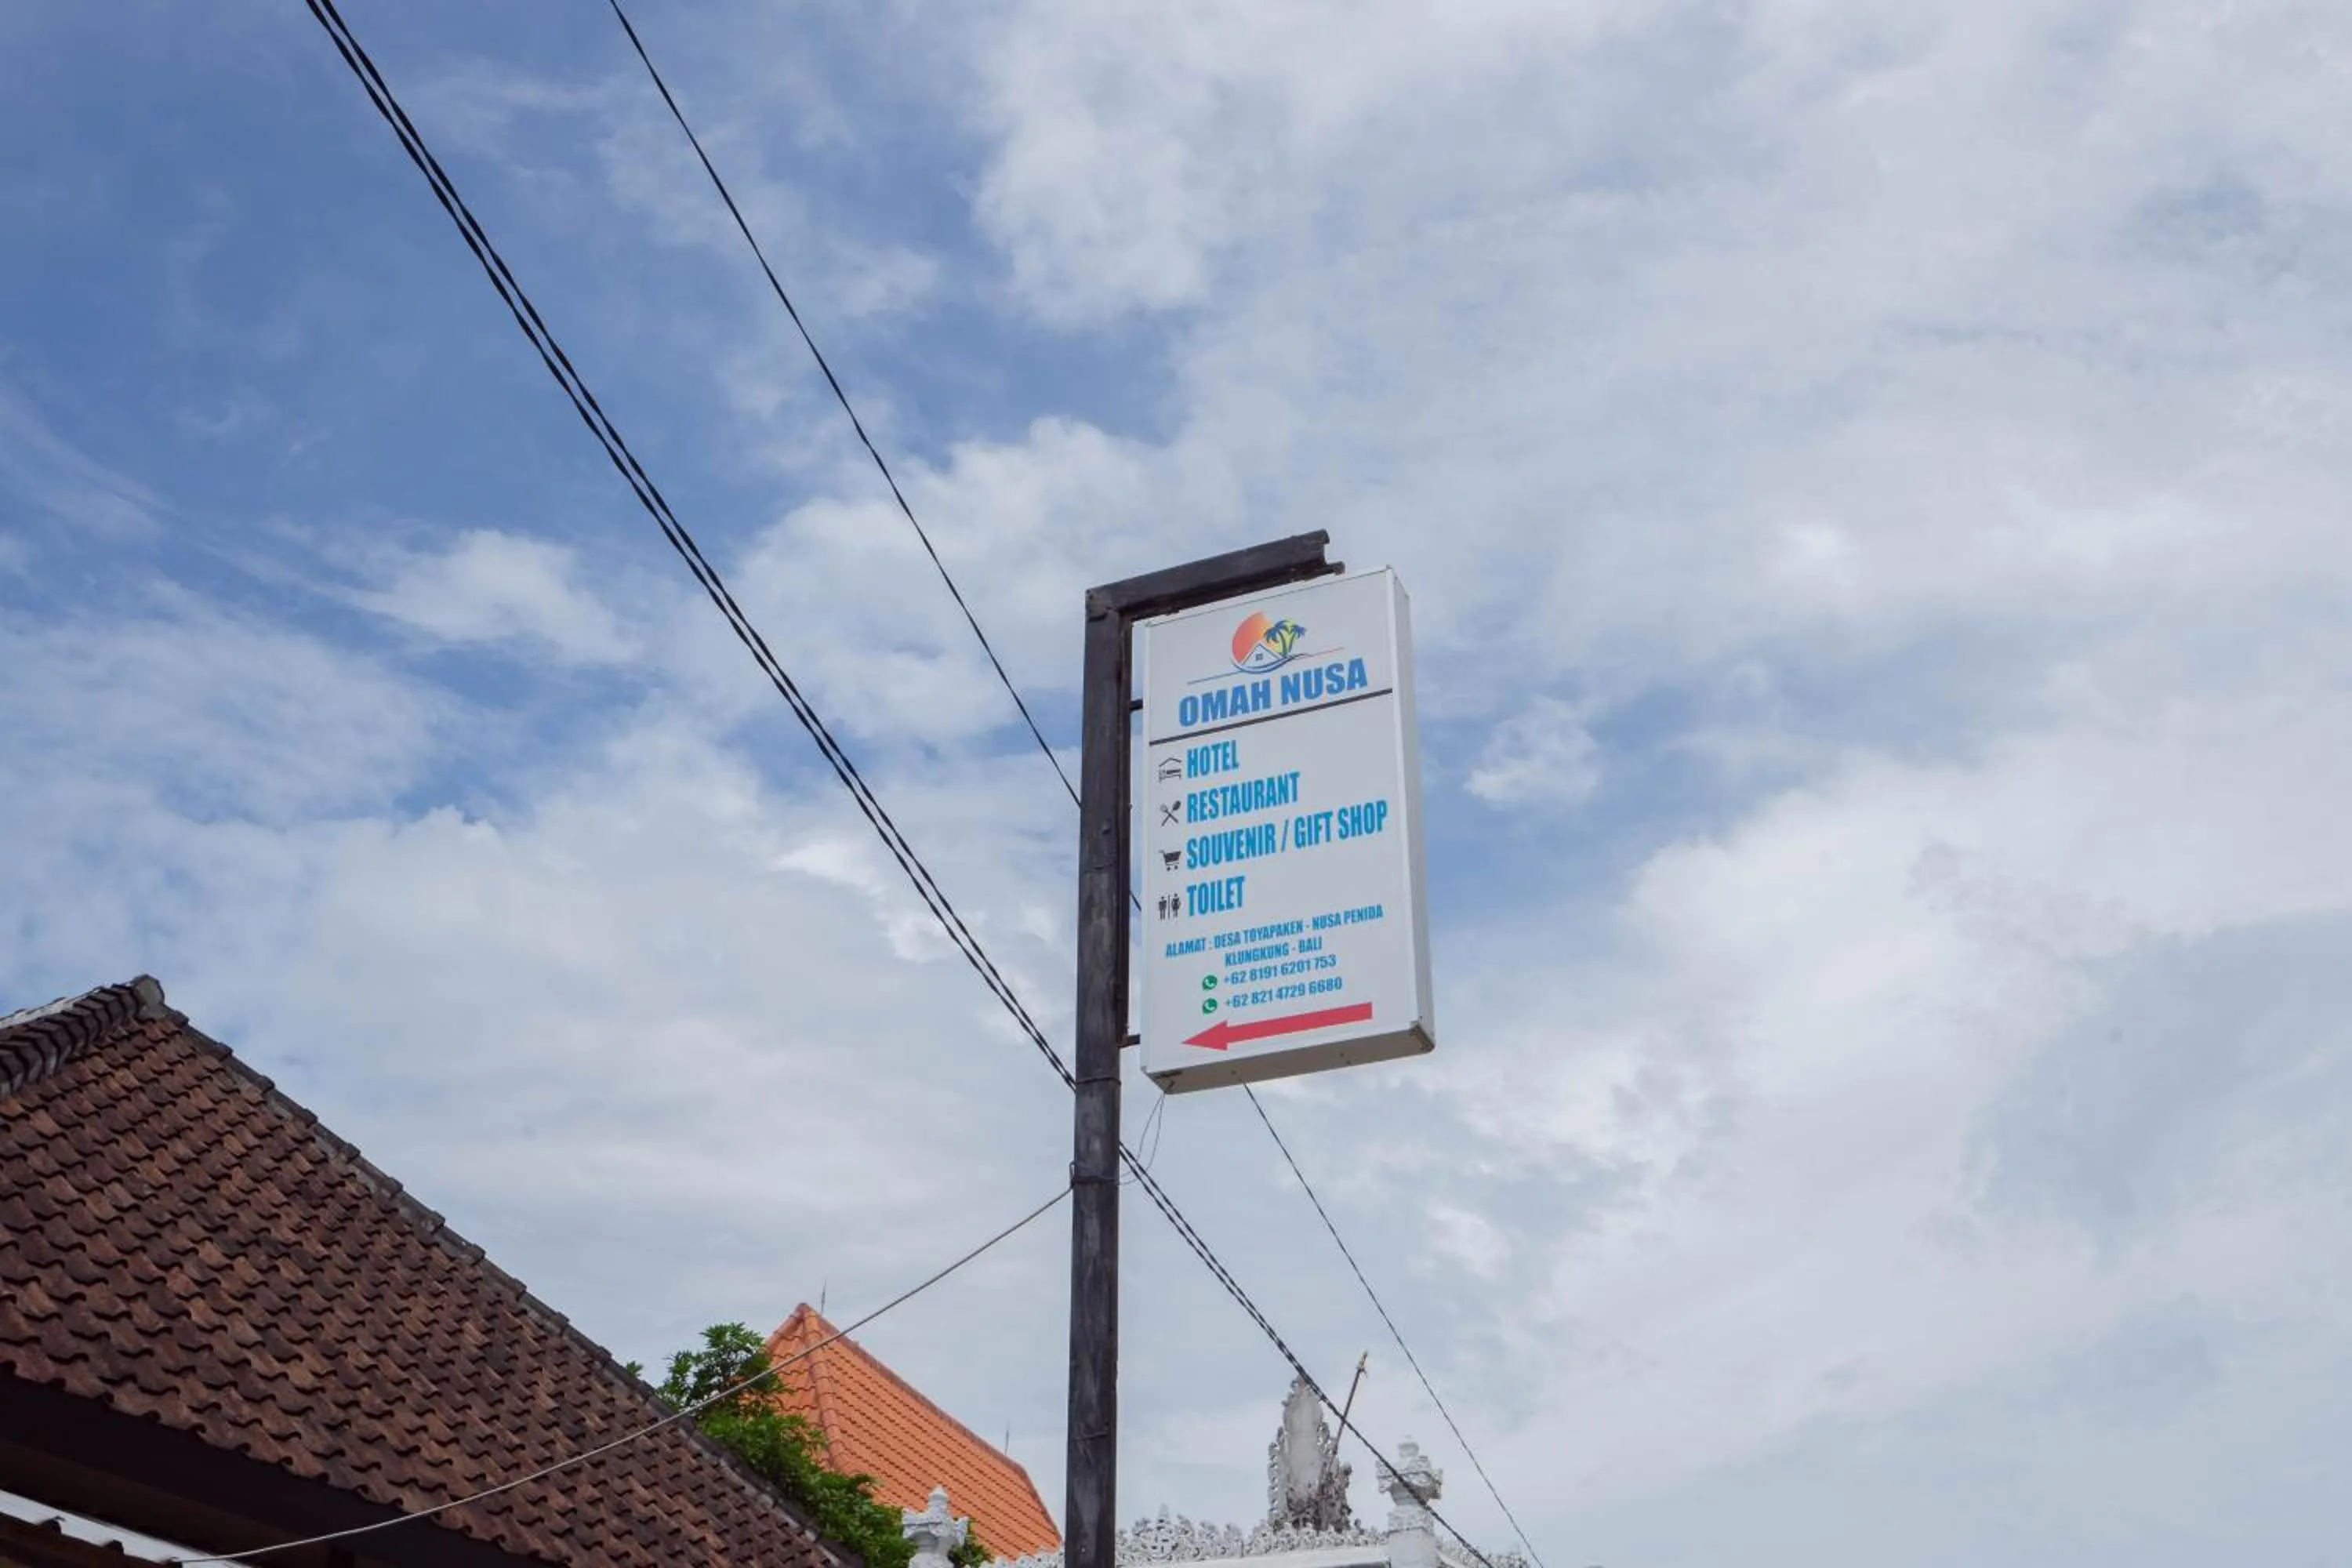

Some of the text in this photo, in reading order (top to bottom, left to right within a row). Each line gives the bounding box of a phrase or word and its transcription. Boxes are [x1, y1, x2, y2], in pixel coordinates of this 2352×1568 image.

[1178, 658, 1367, 727] OMAH NUSA
[1187, 740, 1239, 779] HOTEL
[1187, 771, 1299, 823] RESTAURANT
[1186, 800, 1387, 869] SOUVENIR / GIFT SHOP
[1186, 876, 1245, 916] TOILET
[1166, 938, 1206, 957] ALAMAT
[1214, 931, 1240, 949] DESA
[1312, 913, 1341, 931] NUSA
[1344, 904, 1383, 924] PENIDA
[1224, 954, 1336, 985] +62 8191 6201 753
[1225, 942, 1289, 967] KLUNGKUNG
[1298, 936, 1322, 953] BALI
[1225, 993, 1248, 1007] +62
[1251, 988, 1273, 1004] 821
[1276, 983, 1305, 1000] 4729
